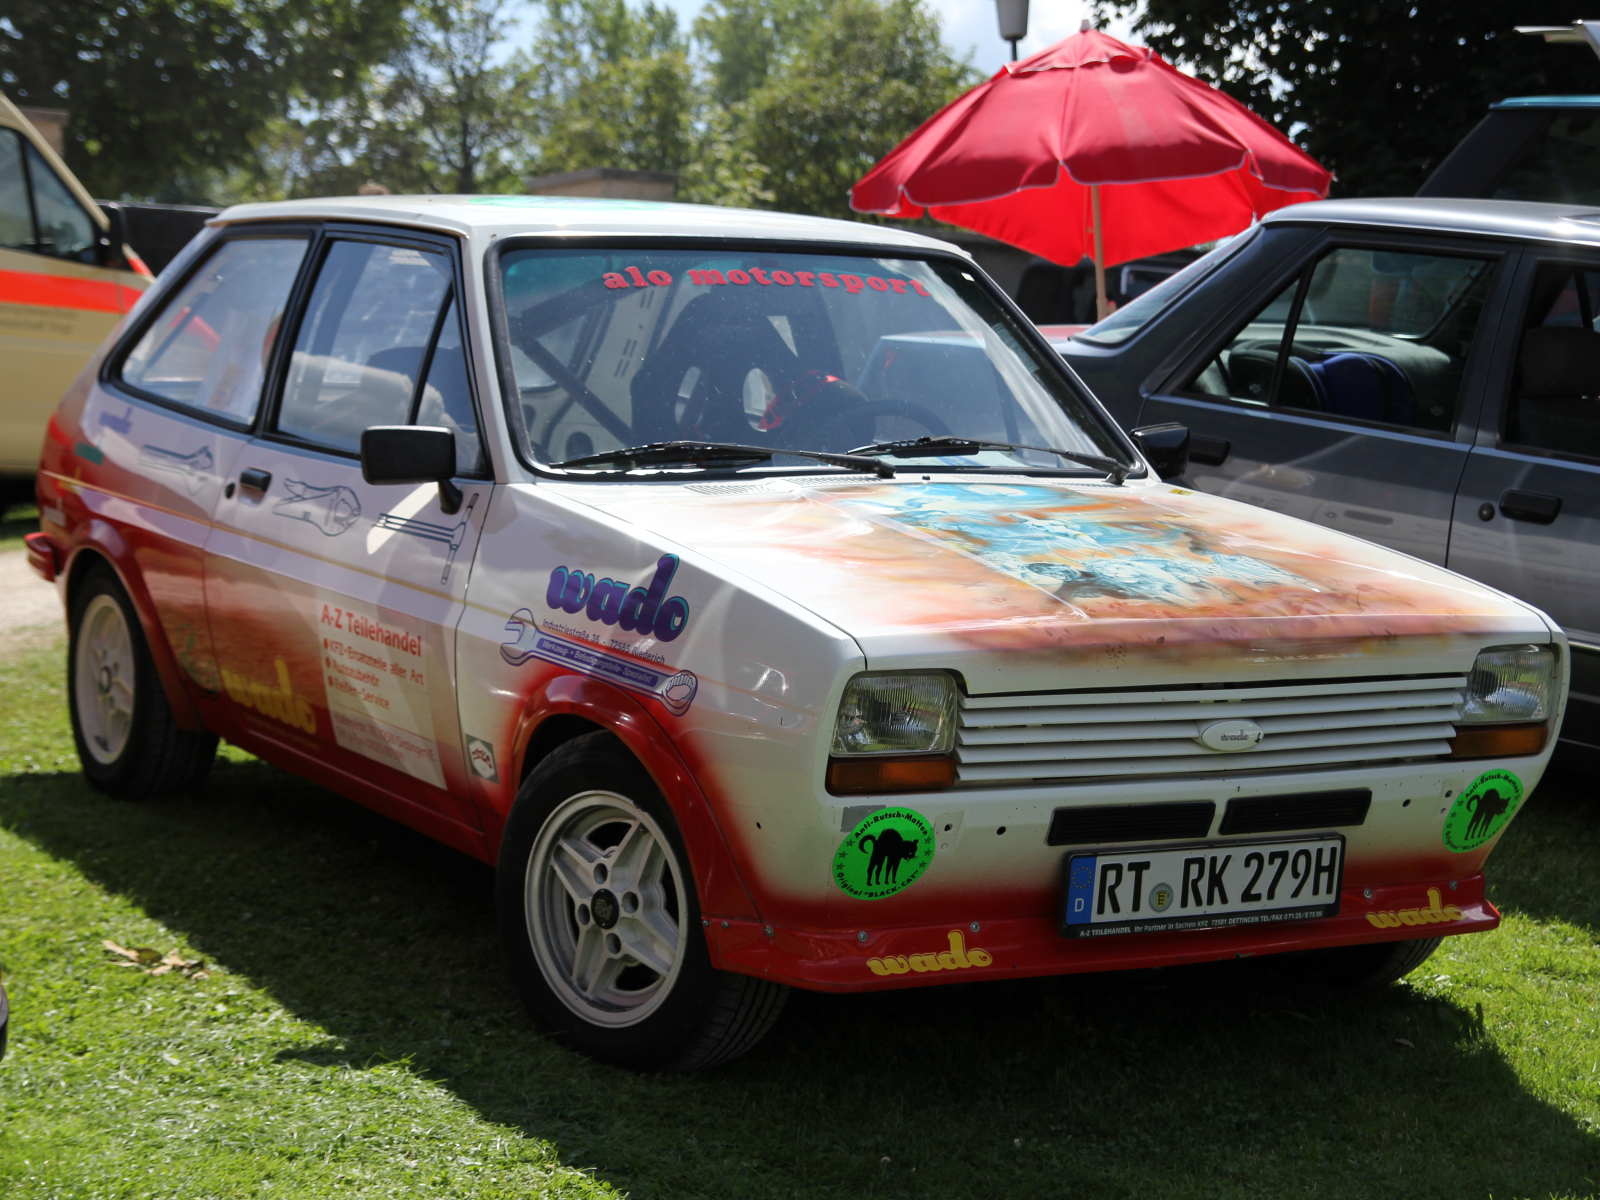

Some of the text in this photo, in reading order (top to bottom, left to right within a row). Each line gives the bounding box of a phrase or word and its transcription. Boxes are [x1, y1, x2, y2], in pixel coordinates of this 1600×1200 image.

[602, 266, 931, 297] alo motorsport
[546, 553, 689, 642] wado
[321, 604, 422, 657] A-Z Teilehandel
[543, 618, 590, 643] Industriestraße
[592, 633, 600, 644] 36
[610, 639, 630, 654] 72585
[632, 646, 665, 665] Riederich
[390, 663, 407, 679] aller
[410, 669, 424, 686] Art
[220, 655, 317, 735] wado
[1465, 772, 1520, 799] Anti-Rutsch-Matten
[855, 810, 928, 839] Anti-Rutsch-Matten
[837, 871, 862, 897] Original
[1097, 846, 1338, 915] RT RK 279H
[1074, 898, 1084, 912] D
[1365, 887, 1467, 928] wado
[1092, 927, 1131, 936] TEILEHANDEL
[1175, 921, 1196, 929] Sachen
[1260, 914, 1283, 922] TEL/FAX
[866, 929, 993, 976] wado
